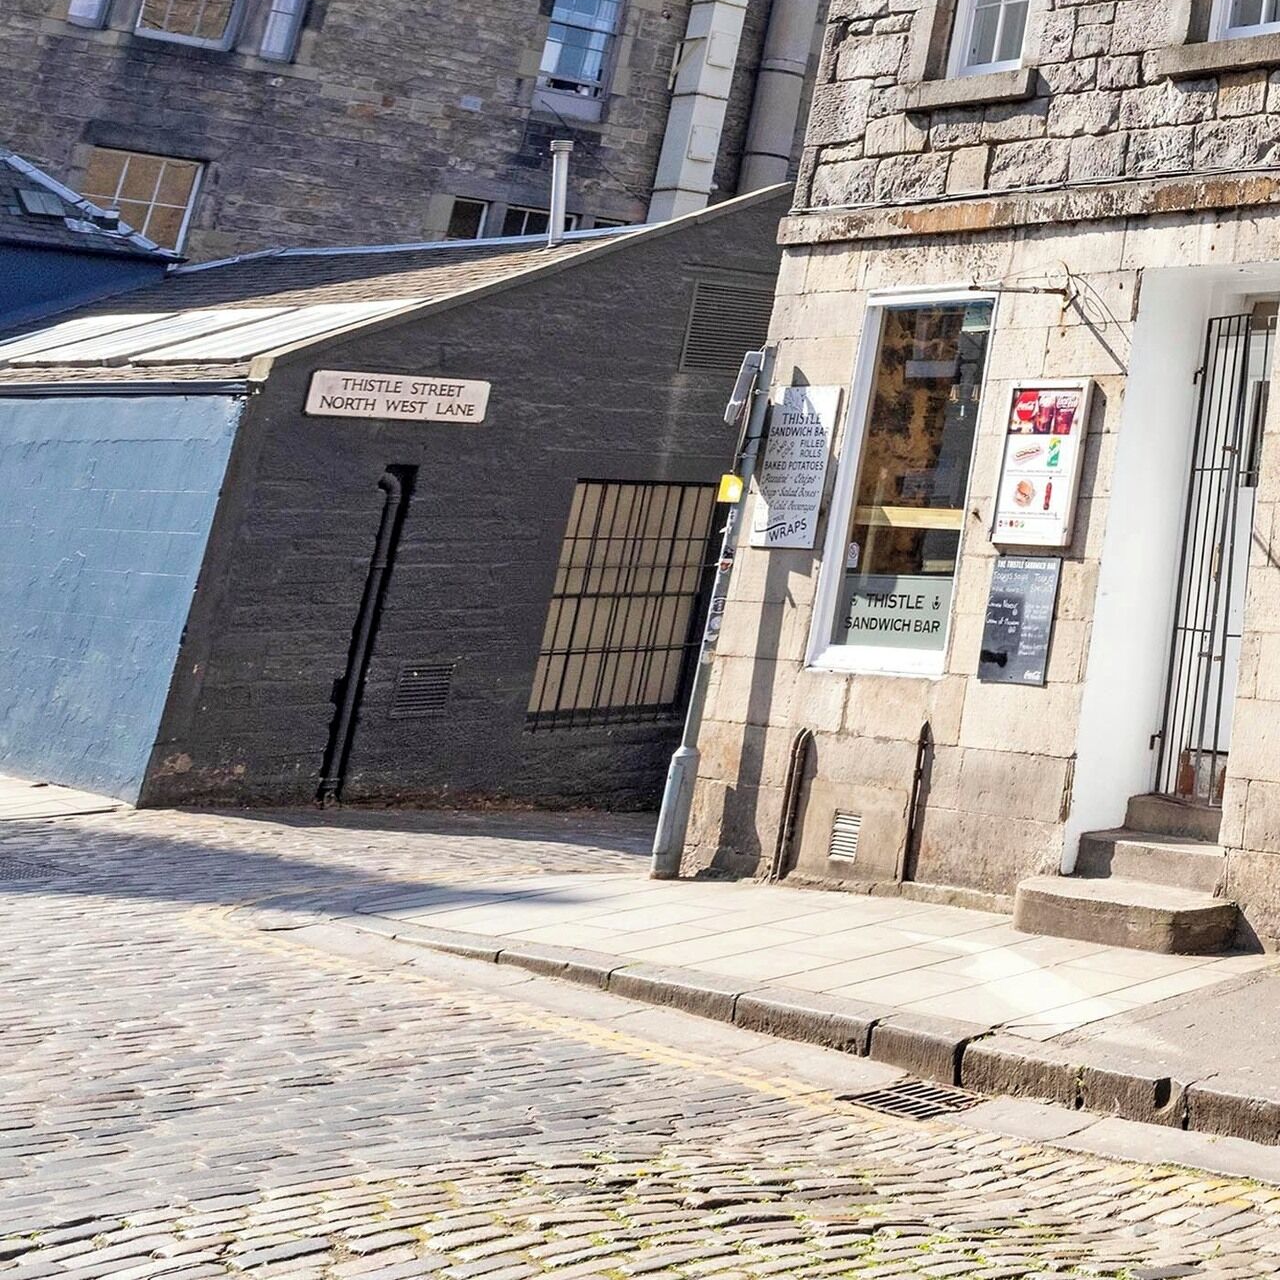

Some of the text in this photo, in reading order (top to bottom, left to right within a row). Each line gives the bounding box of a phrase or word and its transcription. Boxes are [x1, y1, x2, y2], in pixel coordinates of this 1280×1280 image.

[341, 377, 465, 398] THISTLE STREET
[318, 395, 475, 417] NORTH WEST LANE
[782, 412, 823, 425] THISTLE
[770, 426, 812, 437] SANDWICH
[800, 439, 825, 448] FILLED
[800, 449, 822, 458] ROLLS
[763, 461, 824, 471] BAKED POTATOES
[768, 518, 807, 542] WRAPS
[866, 592, 925, 610] THISTLE
[843, 616, 941, 634] SANDWICH BAR
